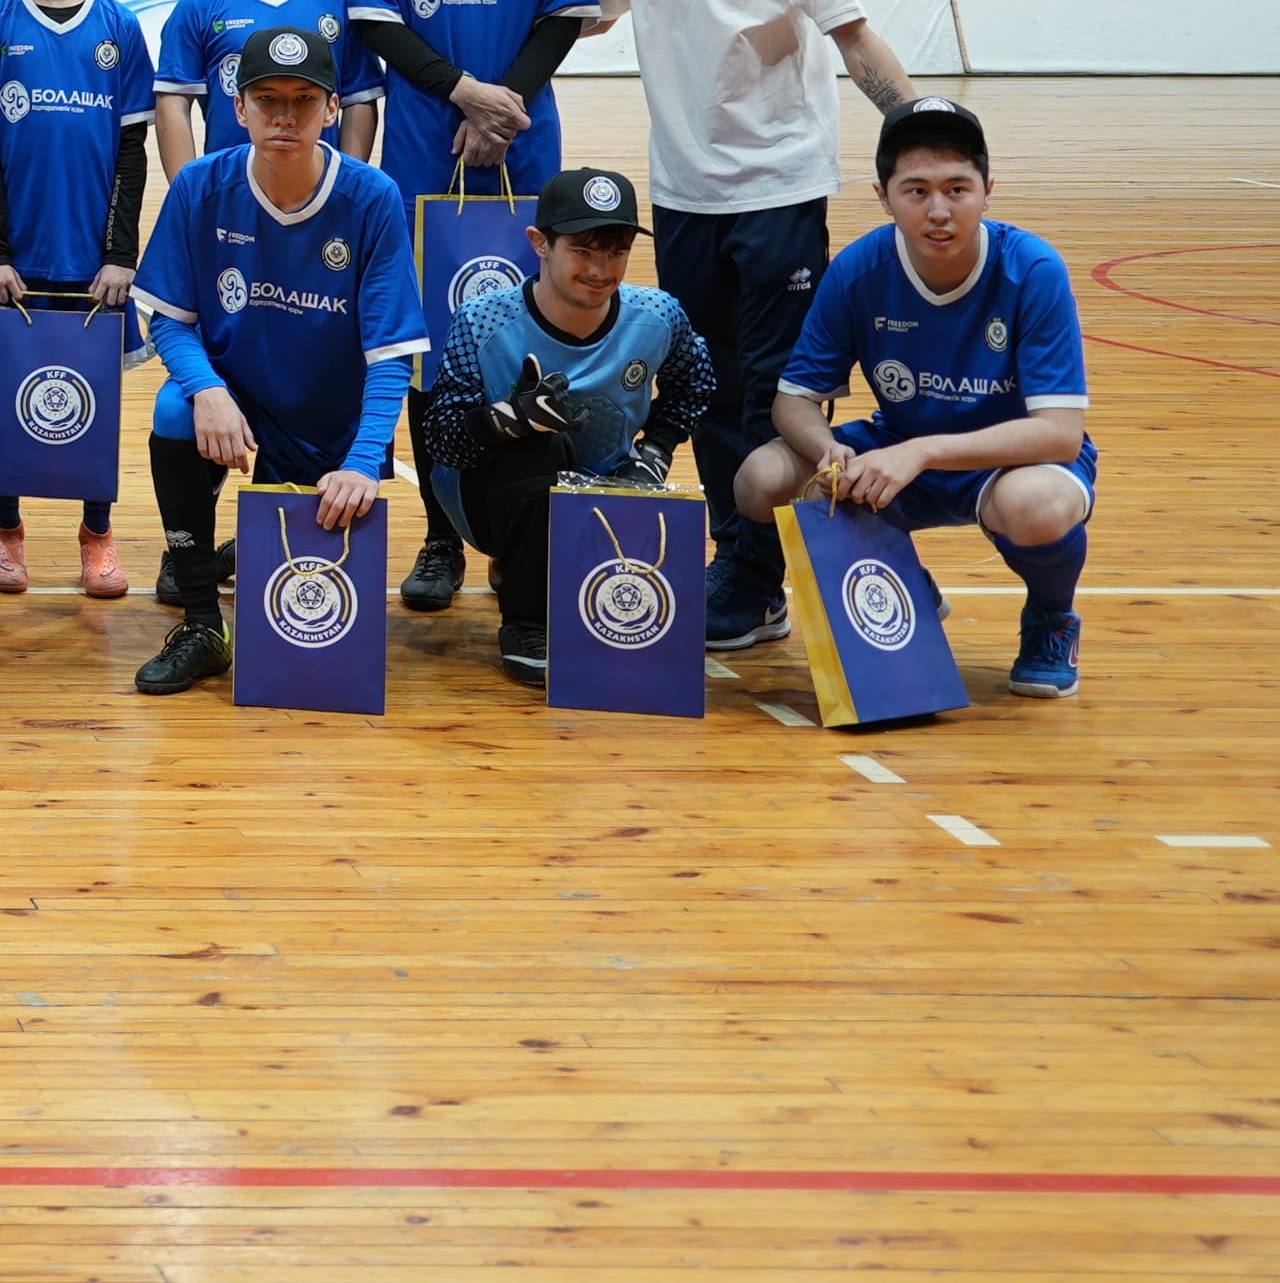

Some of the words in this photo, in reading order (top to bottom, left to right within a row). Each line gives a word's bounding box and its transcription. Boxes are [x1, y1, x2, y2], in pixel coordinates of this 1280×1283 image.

[31, 88, 115, 111] БОЛАШАК
[478, 260, 500, 271] KFF
[248, 282, 347, 315] БОЛАШАК
[887, 319, 920, 329] FREEDOM
[45, 370, 67, 381] KFF
[919, 371, 1017, 396] БОЛАШАК
[27, 416, 83, 440] KAZAKHSTAN
[300, 562, 322, 572] KFF
[860, 563, 877, 575] KFF
[277, 619, 343, 643] KAZAKHSTAN
[590, 622, 659, 644] KAZAKHSTAN
[863, 620, 910, 644] KAZAKHSTAN
